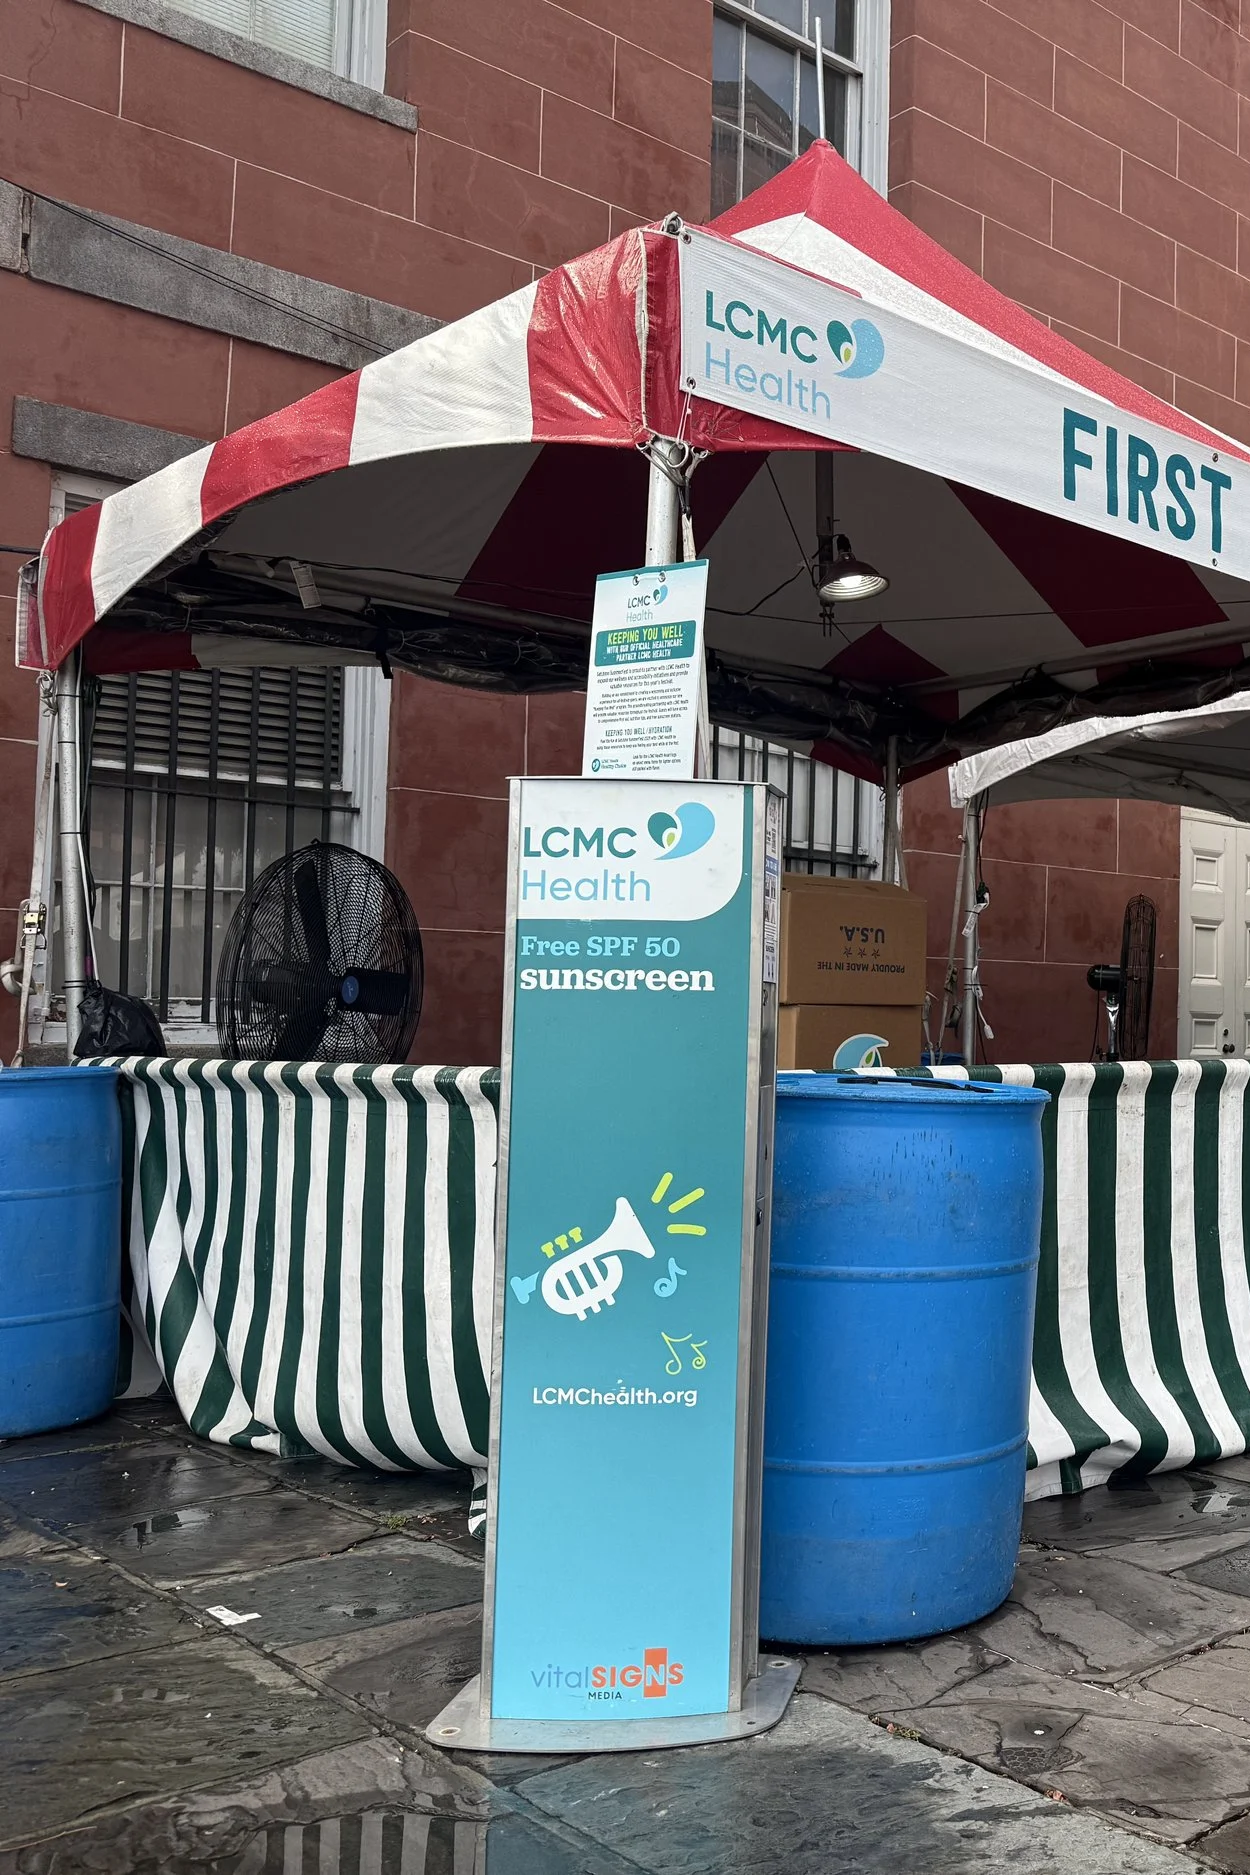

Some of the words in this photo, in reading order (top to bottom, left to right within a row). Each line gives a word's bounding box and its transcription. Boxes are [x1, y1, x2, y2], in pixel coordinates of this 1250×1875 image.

[705, 288, 818, 365] LCMC
[703, 340, 832, 421] Health
[1062, 406, 1232, 554] FIRST
[628, 595, 651, 608] LCMC
[626, 609, 653, 622] Health
[607, 631, 639, 646] KEEPING
[643, 627, 658, 641] YOU
[662, 625, 683, 639] WELL
[606, 645, 618, 654] WITH
[630, 642, 650, 651] OFFICIAL
[652, 638, 683, 649] HEALTHCARE
[616, 652, 637, 662] PARTNER
[638, 651, 651, 660] LCMC
[652, 649, 671, 659] HEALTH
[605, 728, 624, 737] KEEPING
[624, 727, 633, 736] YOU
[633, 726, 645, 735] WELL
[648, 725, 673, 735] HYDRATION
[523, 826, 637, 859] LCMC
[521, 869, 651, 902] Health
[838, 926, 886, 943] U.S.A.
[520, 936, 580, 957] Free
[586, 937, 637, 957] SPF
[645, 937, 680, 957] 50
[816, 961, 831, 972] THE
[833, 961, 844, 972] IN
[846, 962, 868, 973] MADE
[870, 963, 906, 974] PROUDLY
[519, 966, 715, 992] sunscreen
[532, 1386, 698, 1409] LCMChealth.org
[530, 1660, 684, 1692] vitalSIGNS
[587, 1691, 622, 1701] MEDIA
